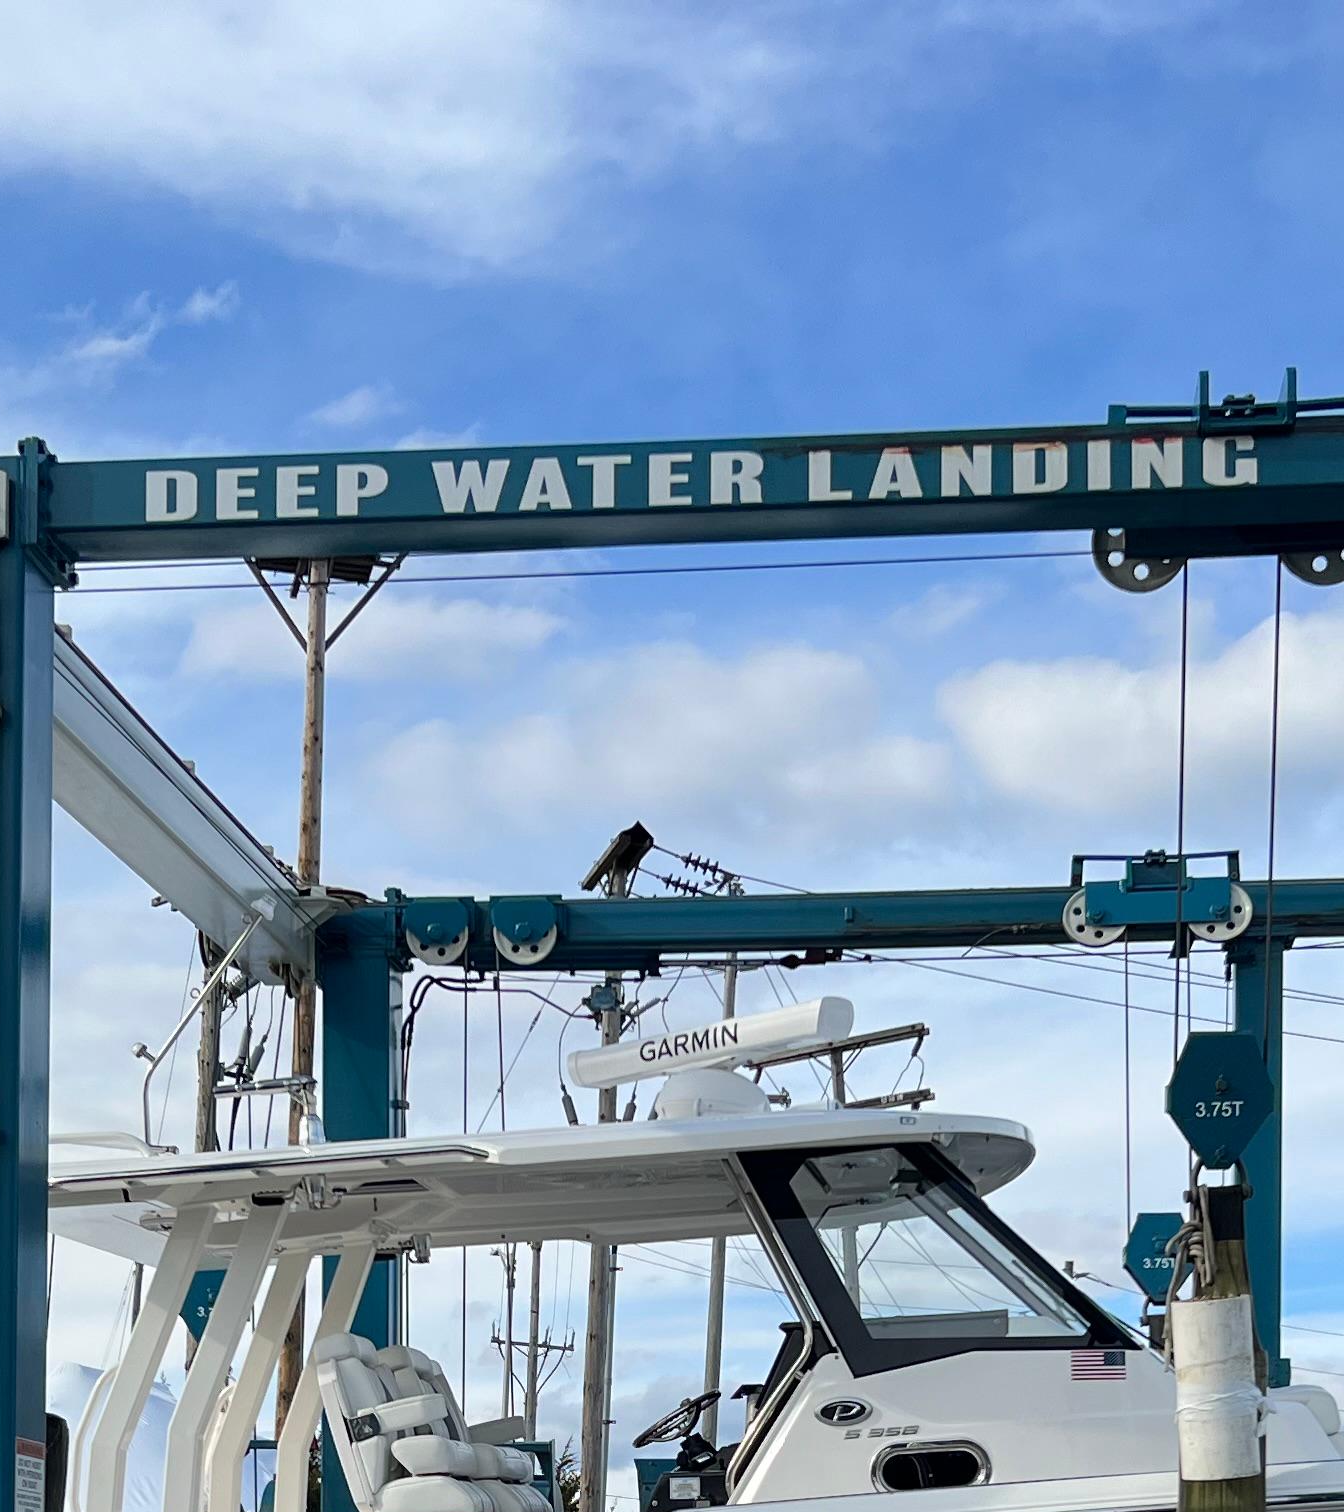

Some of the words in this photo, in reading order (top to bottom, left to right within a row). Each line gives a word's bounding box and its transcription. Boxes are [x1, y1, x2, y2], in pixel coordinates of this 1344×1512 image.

[145, 464, 389, 522] DEEP
[431, 451, 764, 514] WATER
[808, 436, 1257, 502] LANDING
[640, 1023, 738, 1062] GARMIN
[1195, 1101, 1244, 1118] 3.75T
[866, 1425, 920, 1439] 358
